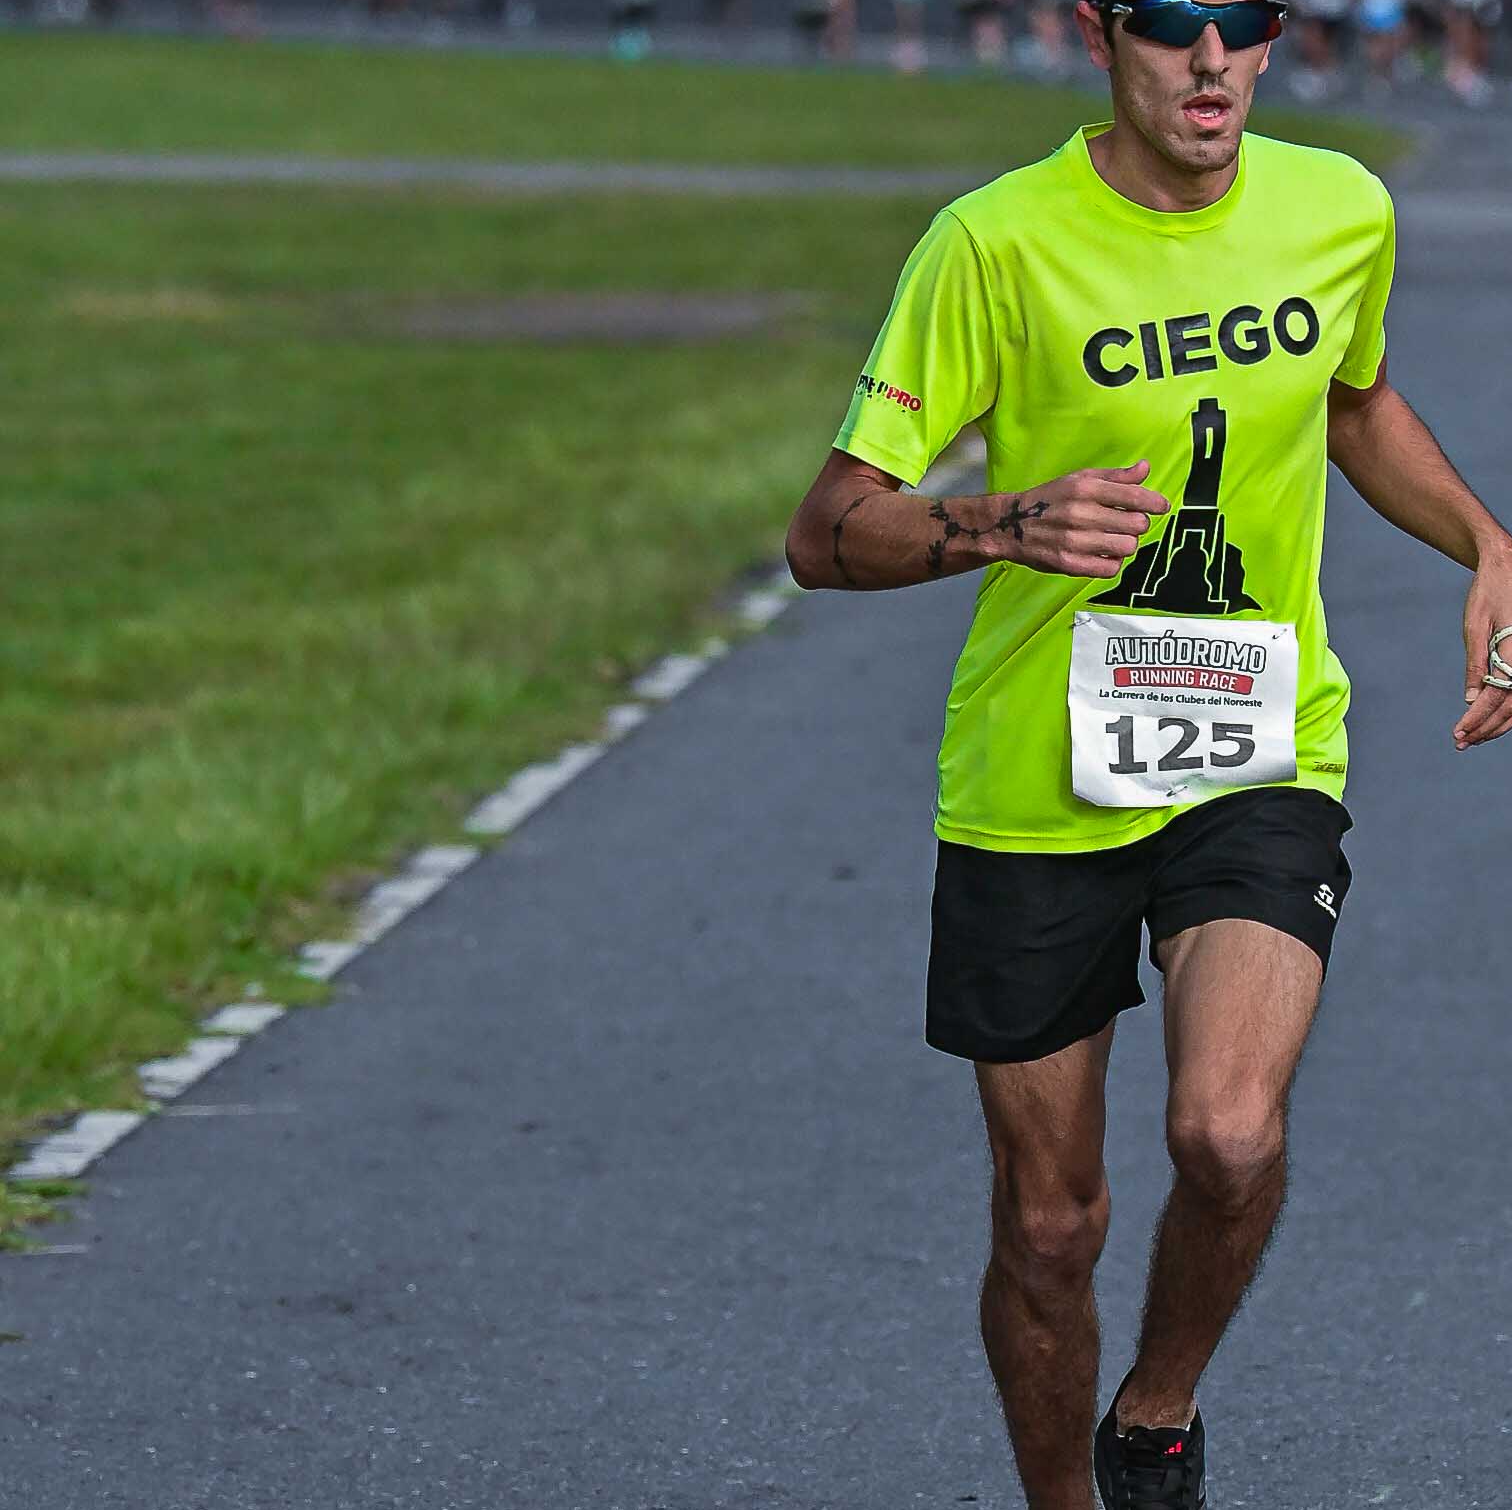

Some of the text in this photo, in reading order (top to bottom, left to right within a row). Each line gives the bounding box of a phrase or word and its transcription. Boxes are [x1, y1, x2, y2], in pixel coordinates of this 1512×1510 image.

[1082, 296, 1320, 387] CIEGO
[1105, 629, 1267, 674] AUTÓDROMO
[1099, 689, 1263, 708] La Carrera de los Clubes del Noroeste
[1129, 669, 1238, 691] RUNNING RACE
[1105, 715, 1256, 775] 125
